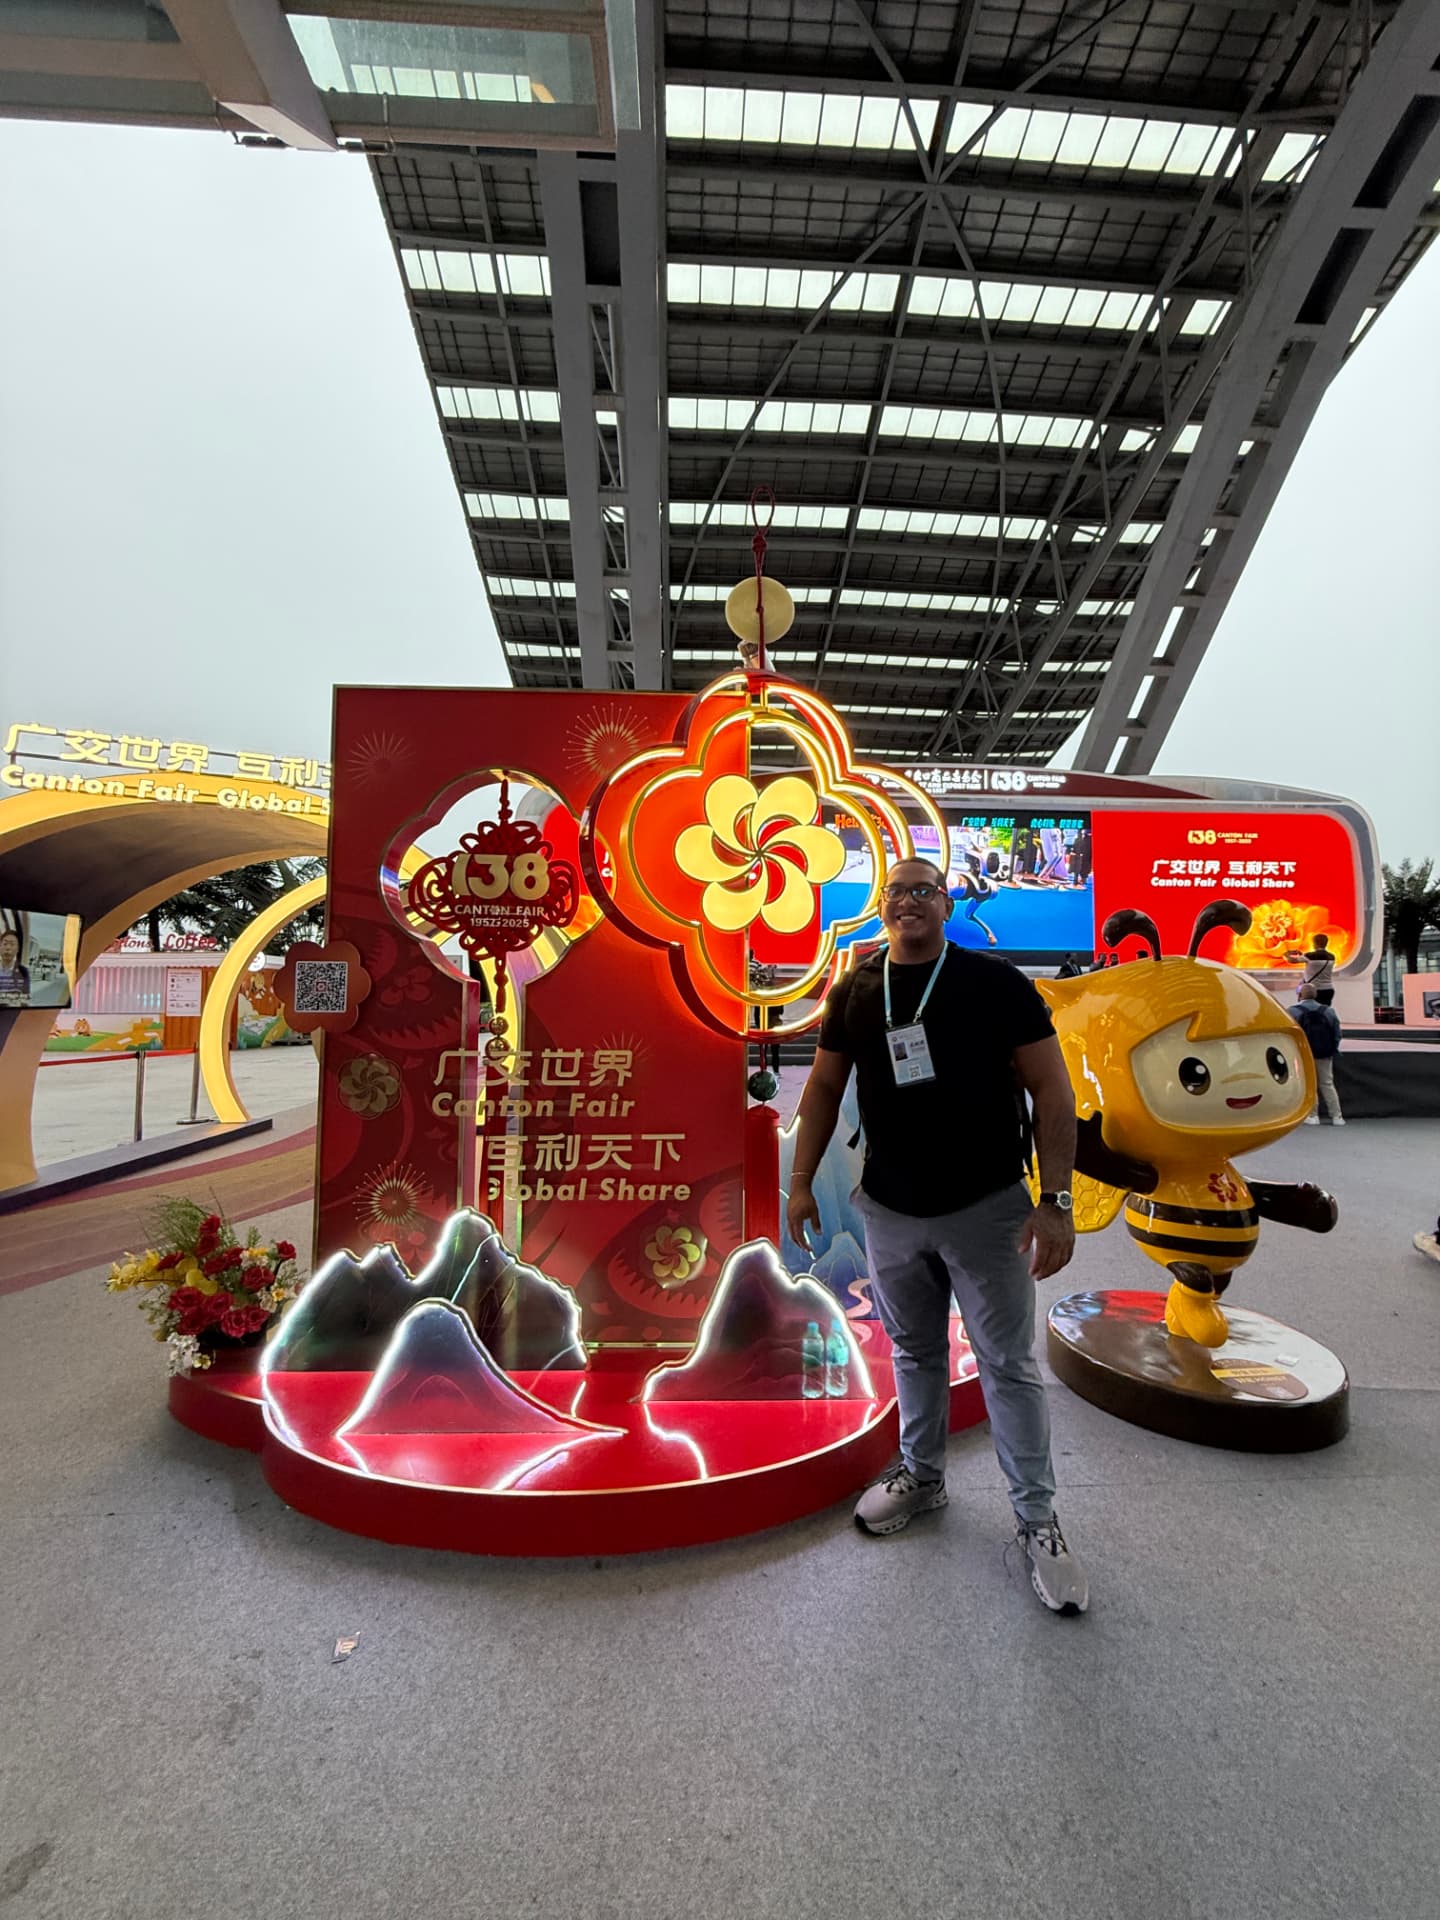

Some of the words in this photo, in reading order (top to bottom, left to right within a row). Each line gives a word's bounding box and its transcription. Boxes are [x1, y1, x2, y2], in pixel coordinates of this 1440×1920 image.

[3, 722, 208, 775] 广交世界
[1, 764, 125, 796] Canton
[137, 779, 199, 804] Fair
[217, 788, 312, 814] Global
[991, 771, 1027, 791] 138
[1188, 829, 1217, 845] 138
[452, 853, 549, 900] 138
[1152, 859, 1220, 875] 广交世界
[1228, 861, 1297, 875] 互利天下
[1151, 877, 1192, 888] Canton
[1194, 877, 1218, 888] Fair
[1221, 877, 1260, 888] Global
[1262, 878, 1295, 888] Share
[454, 904, 510, 915] CANTON
[516, 906, 545, 916] FAIR
[163, 931, 217, 949] Coffee
[433, 1048, 633, 1087] 广交世界
[432, 1092, 554, 1117] Canton
[568, 1092, 636, 1118] Fair
[485, 1132, 686, 1171] 互利天下
[487, 1177, 587, 1201] Global
[599, 1177, 691, 1201] Share
